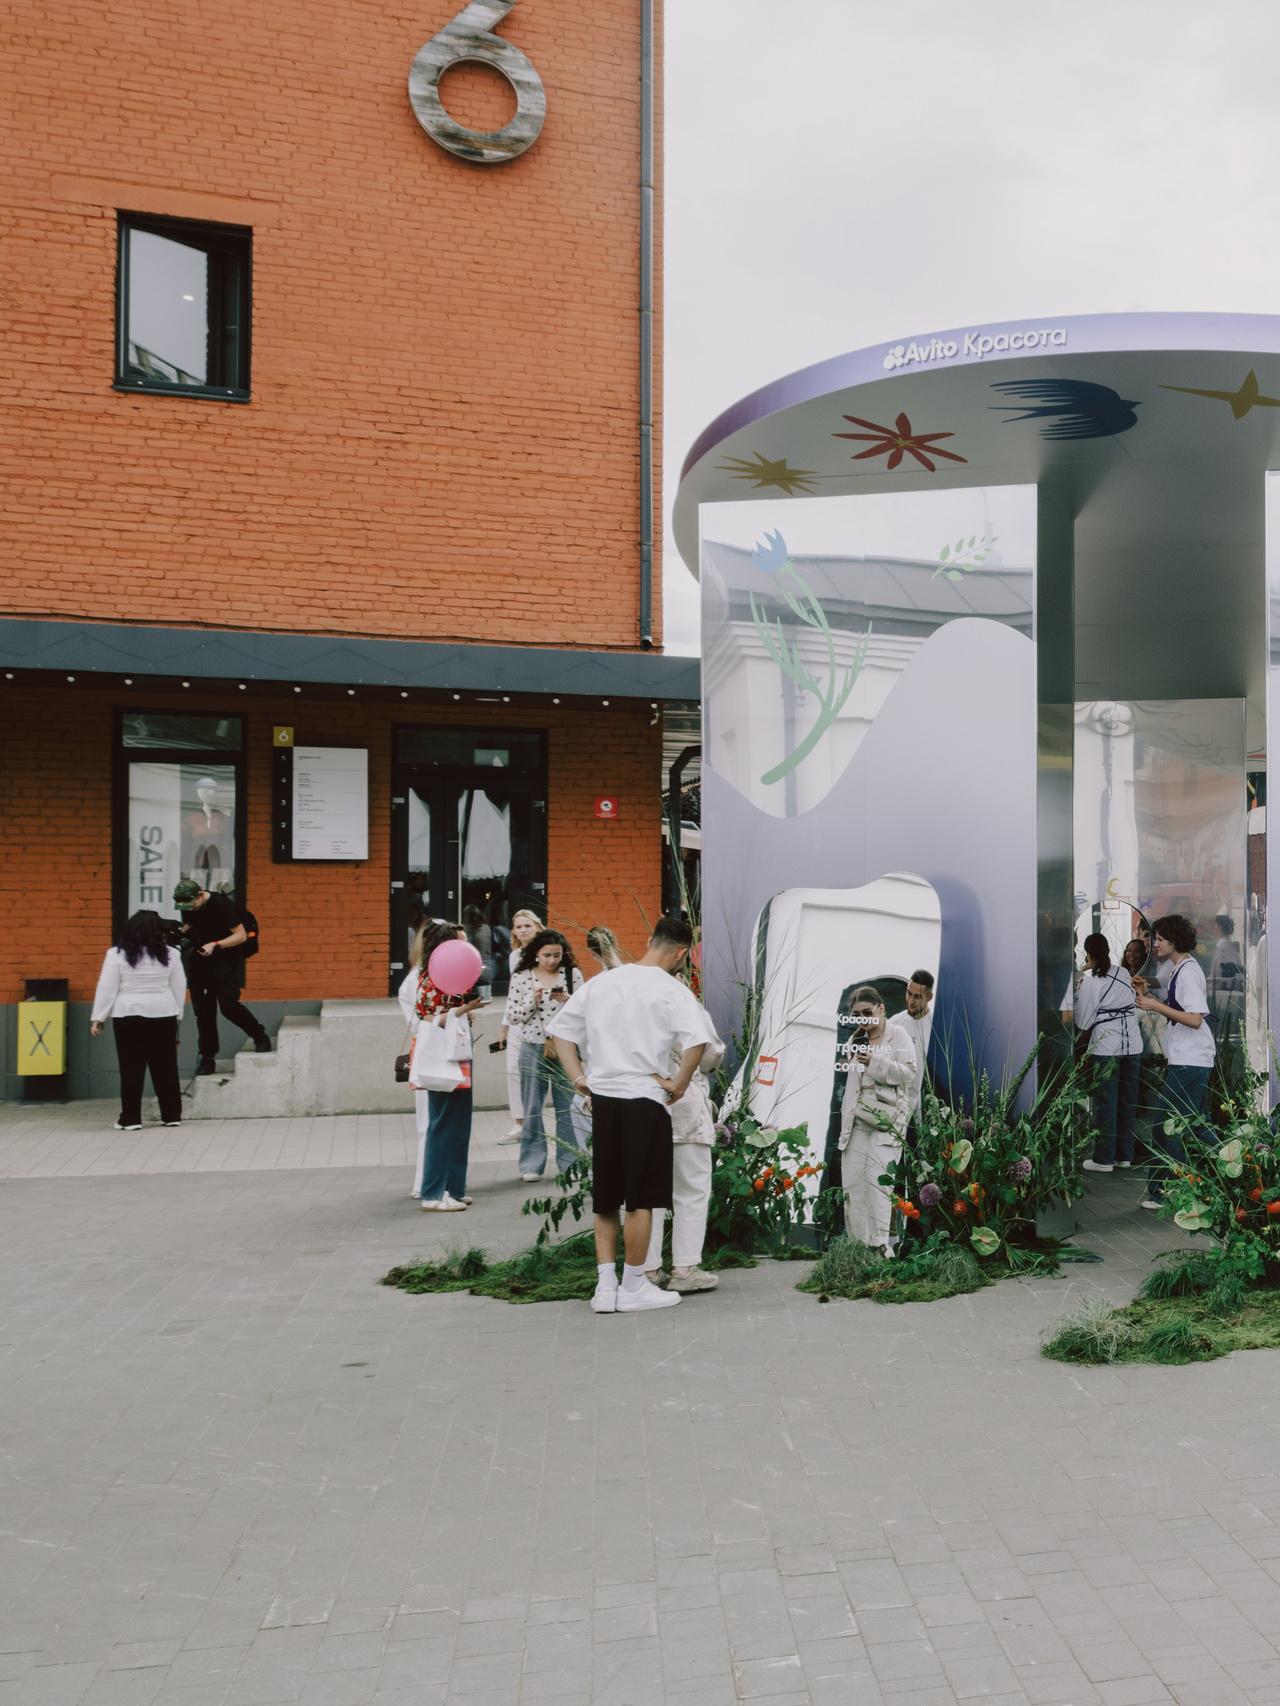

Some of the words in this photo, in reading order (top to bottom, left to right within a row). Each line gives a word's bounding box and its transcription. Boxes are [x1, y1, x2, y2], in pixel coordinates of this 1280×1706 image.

[409, 0, 547, 163] 6
[903, 338, 958, 366] Avito
[962, 328, 1068, 358] Красота
[278, 730, 289, 742] 6
[281, 821, 287, 829] 2
[139, 825, 163, 904] SALE
